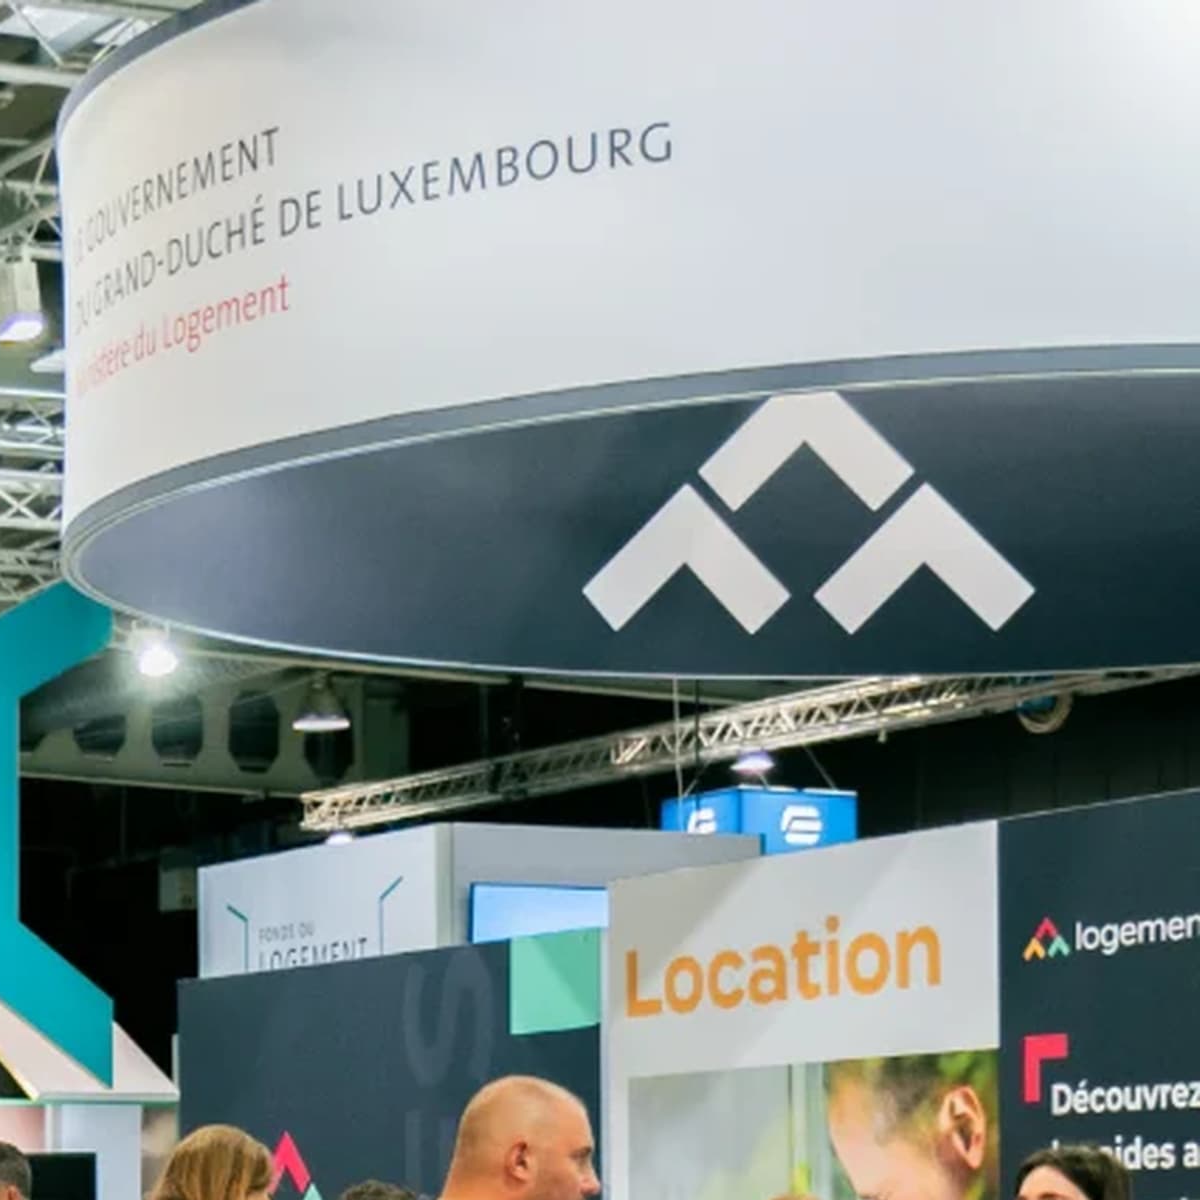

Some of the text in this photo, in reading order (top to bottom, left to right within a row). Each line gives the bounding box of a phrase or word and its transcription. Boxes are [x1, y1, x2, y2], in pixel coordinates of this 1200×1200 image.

[87, 126, 280, 254] GOUVERNEMENT
[94, 192, 266, 317] GRAND-DUCHÉ
[279, 190, 322, 238] DE
[337, 122, 674, 222] LUXEMBOURG
[134, 318, 158, 362] du
[162, 273, 291, 353] Logement
[625, 914, 943, 1018] Location
[1051, 1078, 1200, 1116] Découvrez
